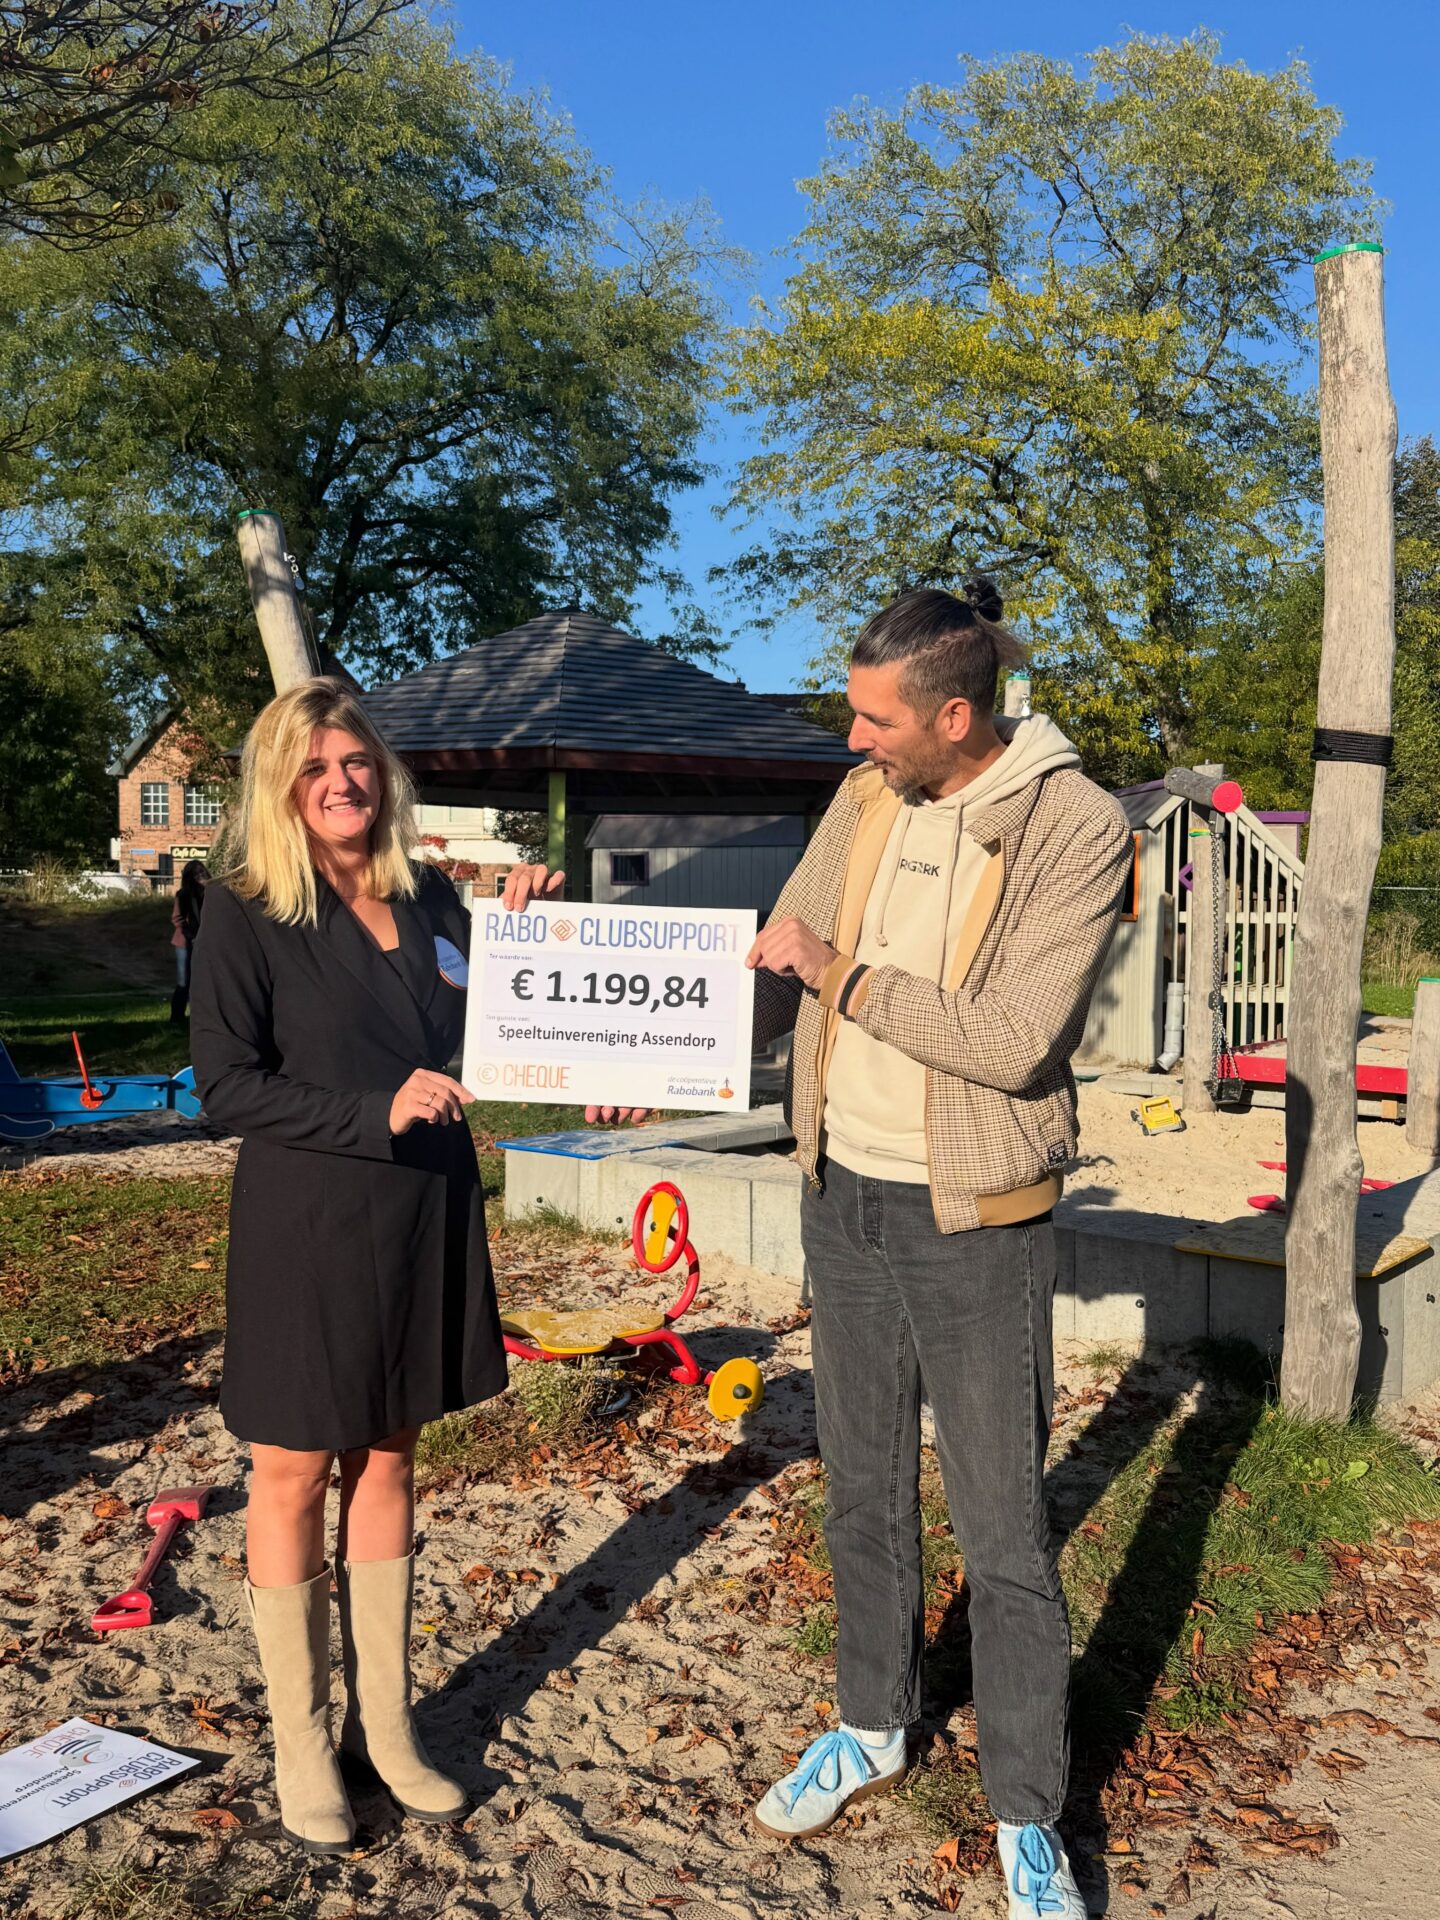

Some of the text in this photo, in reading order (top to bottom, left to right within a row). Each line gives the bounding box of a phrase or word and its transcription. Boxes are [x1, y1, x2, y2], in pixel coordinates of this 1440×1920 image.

[485, 912, 740, 952] RABO CLUBSUPPORT
[511, 969, 709, 1013] € 1.199,84
[498, 1024, 717, 1051] Speeltuinvereniging Assendorp
[503, 1063, 571, 1089] CHEQUE
[666, 1085, 716, 1097] Rabobank
[22, 1727, 90, 1759] CHEQUE
[14, 1765, 69, 1793] Assendorp
[51, 1752, 165, 1809] CLUBSUPPORT
[133, 1757, 183, 1780] RABO
